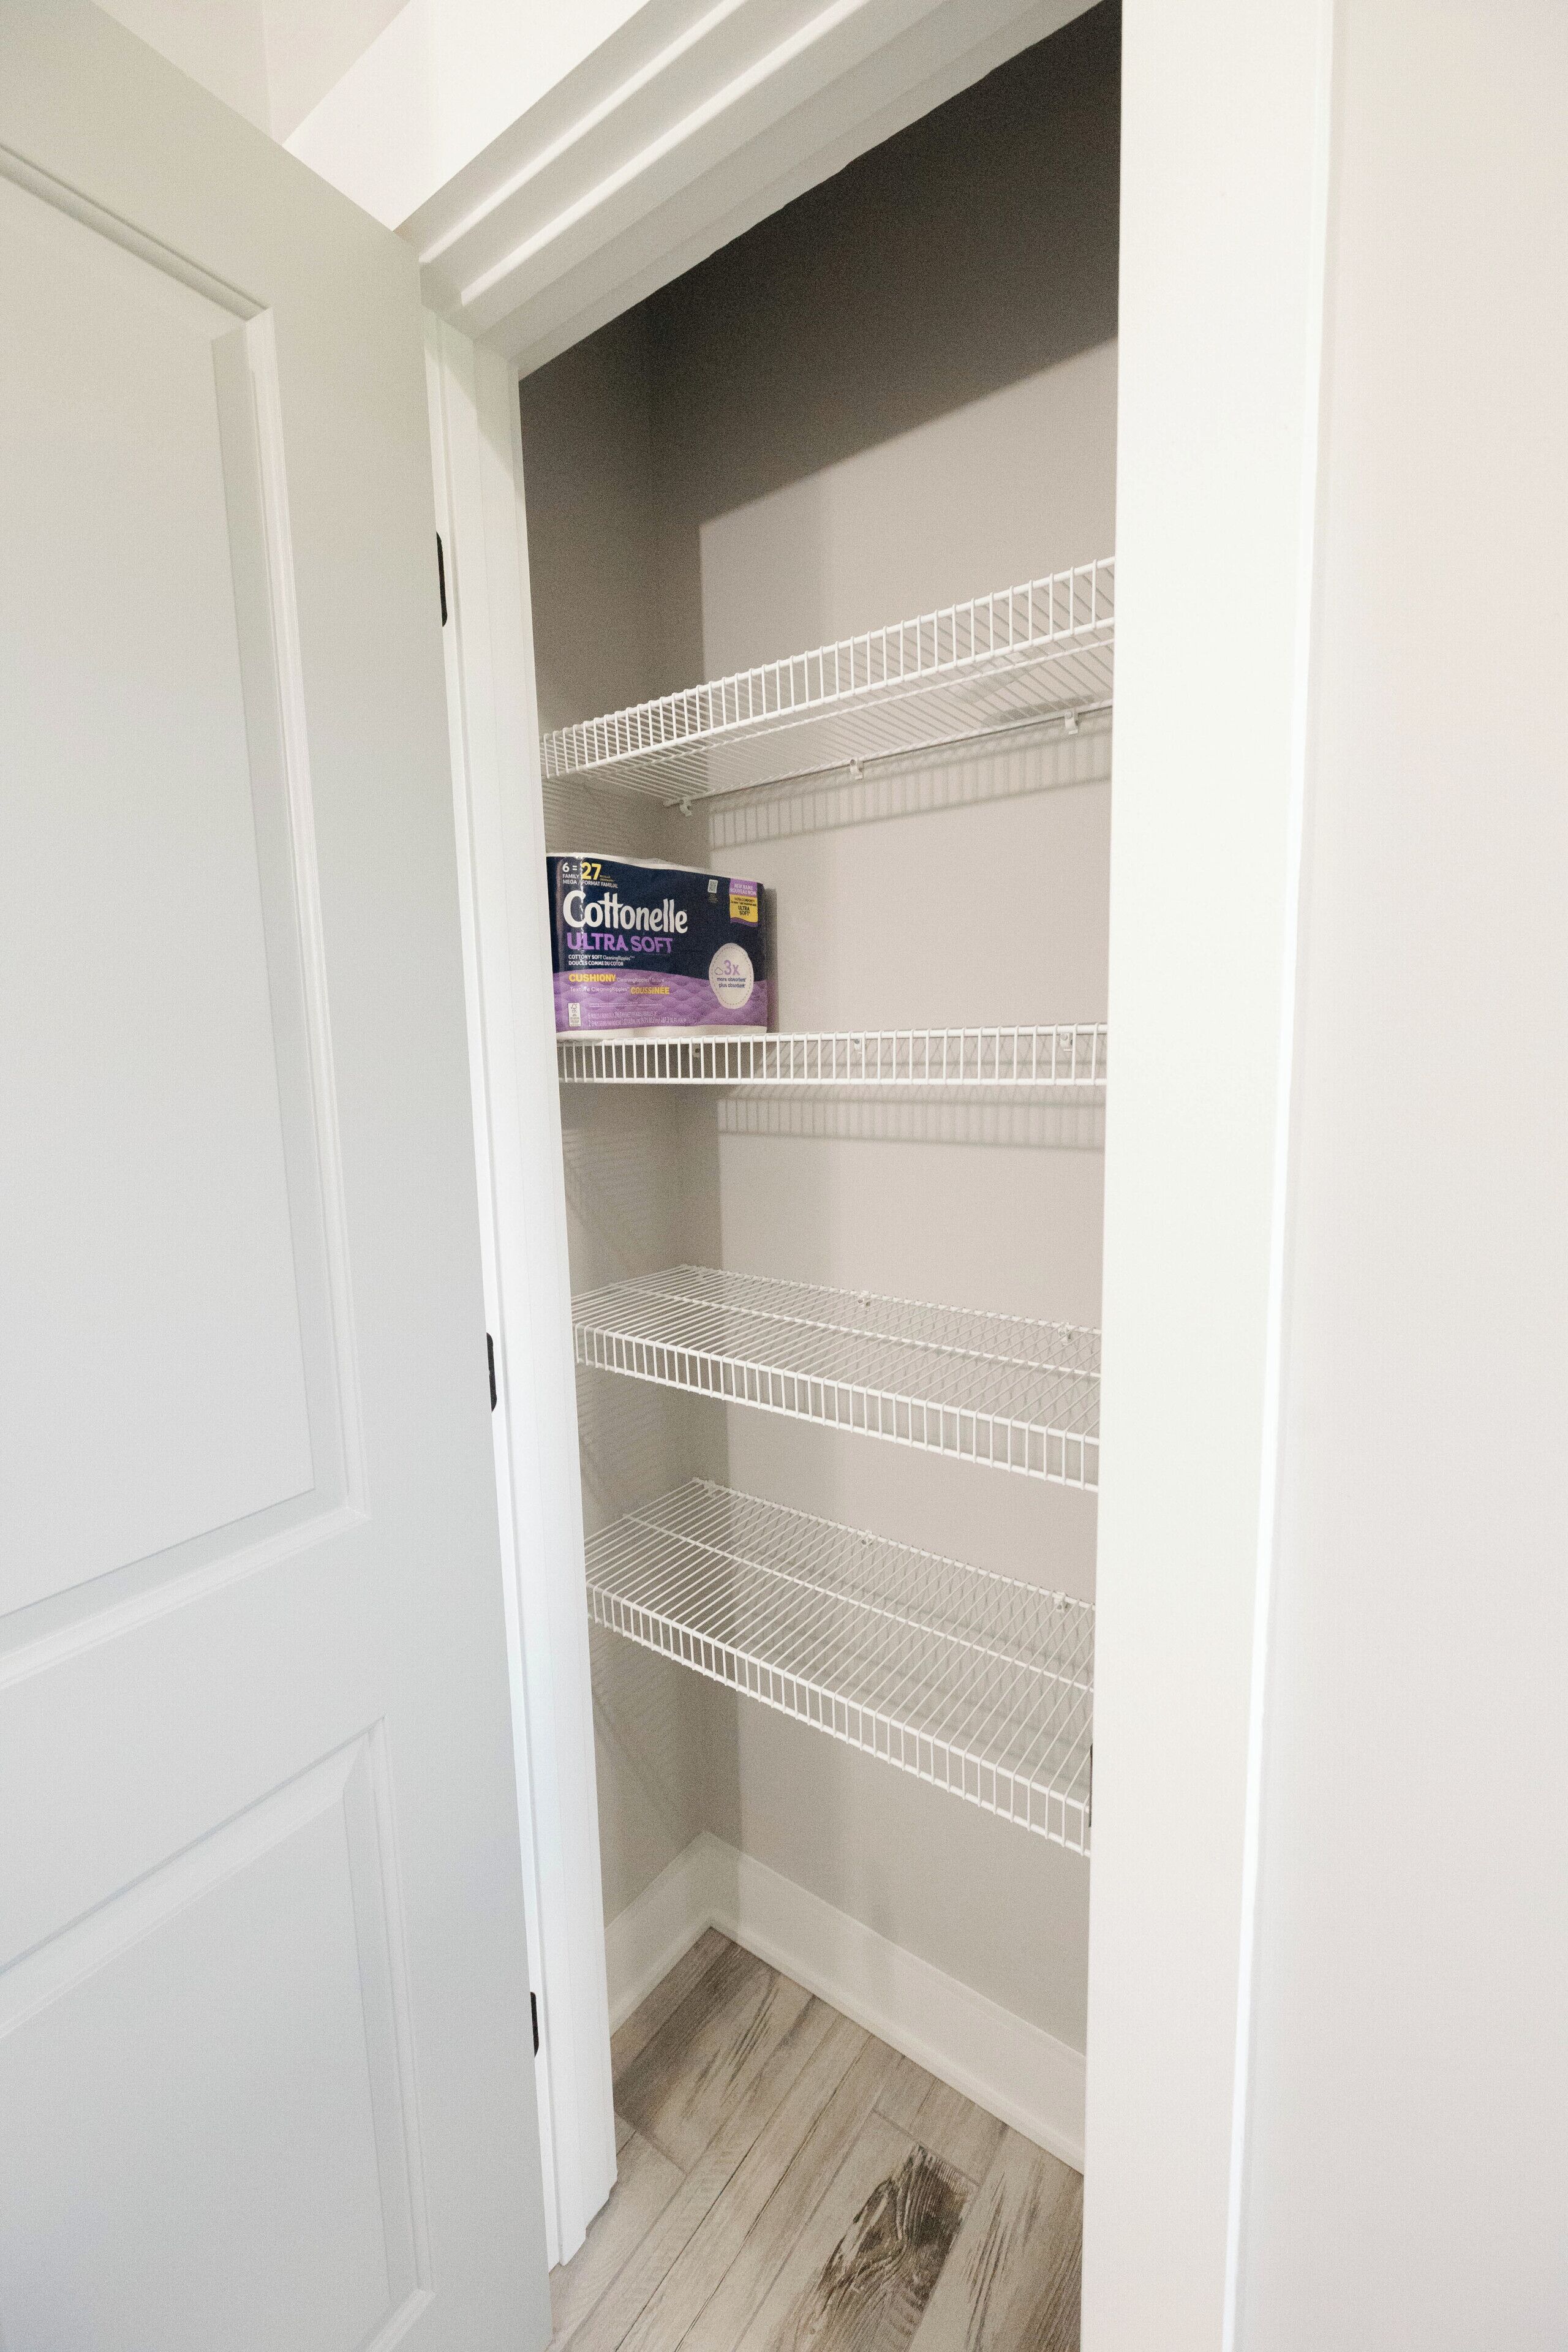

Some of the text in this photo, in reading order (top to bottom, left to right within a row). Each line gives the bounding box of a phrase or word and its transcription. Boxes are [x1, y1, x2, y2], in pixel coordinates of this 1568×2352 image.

[562, 862, 570, 872] 6
[581, 862, 601, 880] 27
[562, 890, 688, 934] Cottonelle
[567, 932, 673, 954] ULTRA SOFT
[723, 959, 740, 975] 3x
[568, 973, 616, 982] CUSHIONY
[630, 985, 670, 995] COUSSINÉE
